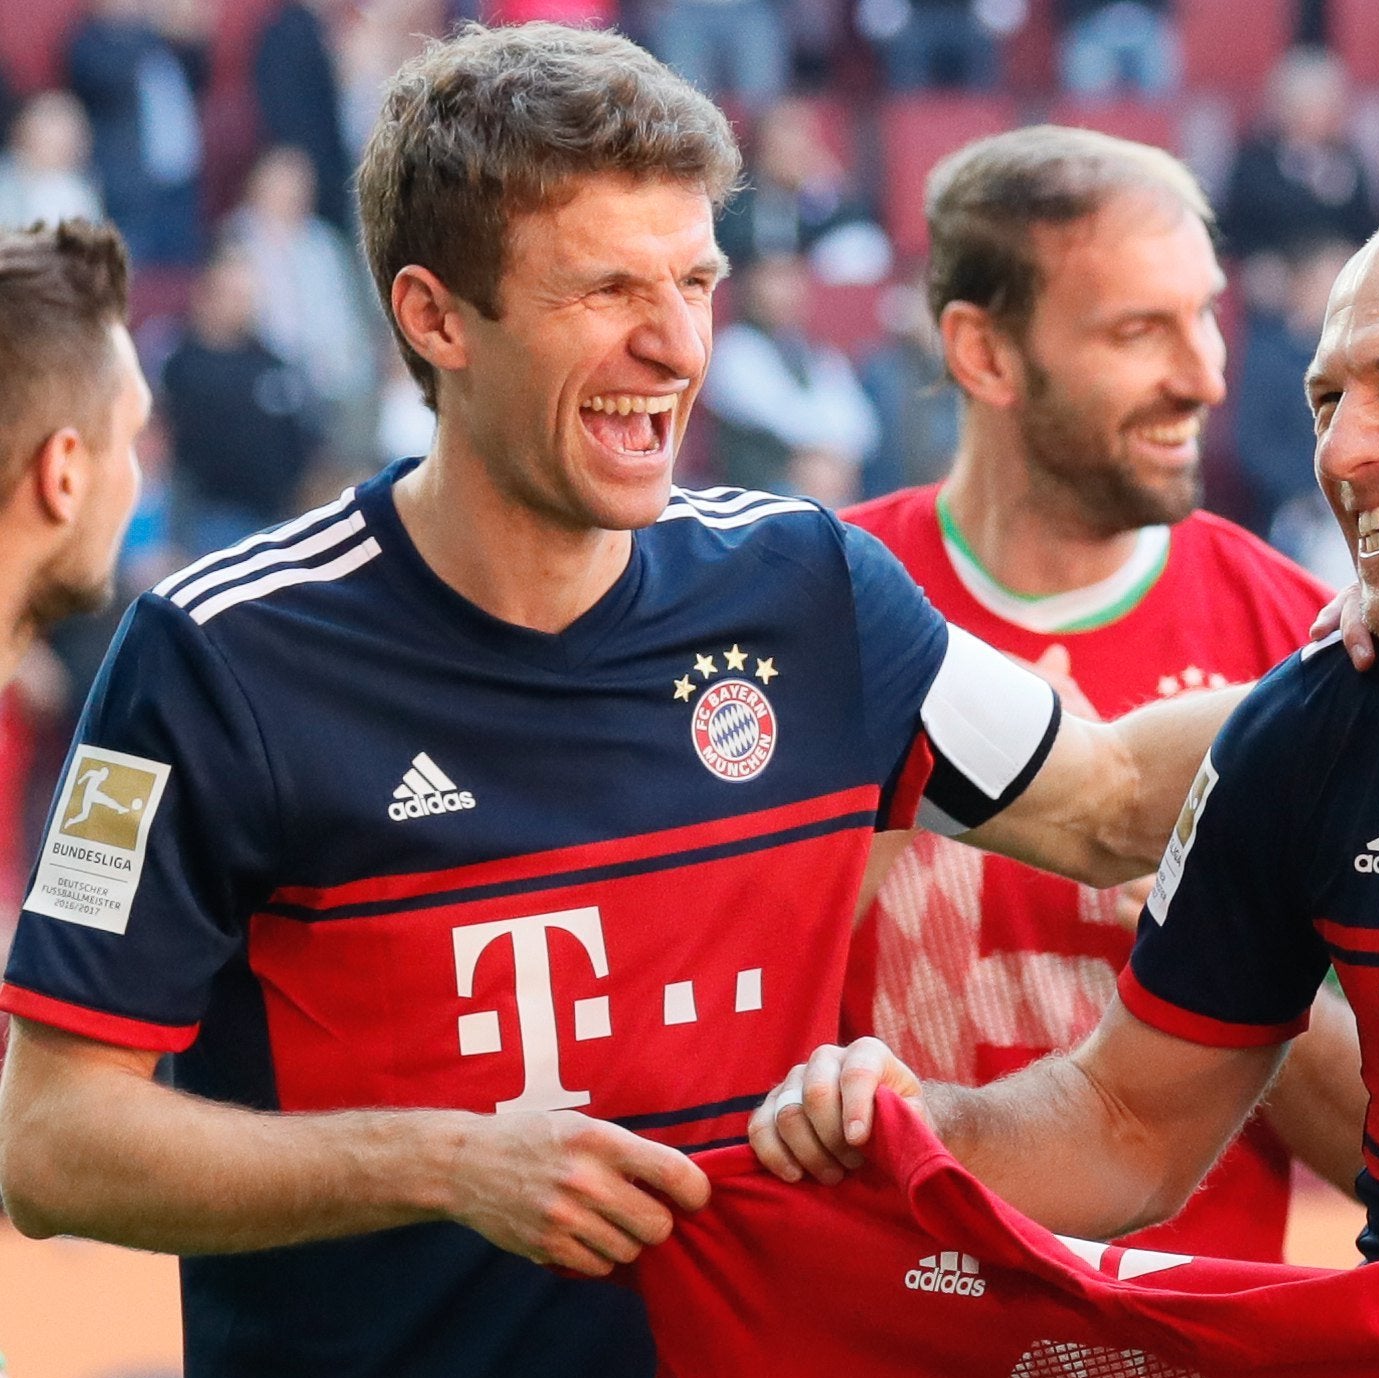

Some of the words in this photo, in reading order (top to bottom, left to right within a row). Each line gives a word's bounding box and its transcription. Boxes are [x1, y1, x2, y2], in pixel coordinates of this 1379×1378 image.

[696, 707, 710, 731] FC
[709, 685, 768, 719] BAYERN
[388, 788, 476, 822] adidas
[52, 842, 132, 872] BUNDESLIGA
[42, 885, 121, 911] FUSSBALLMEISTER
[58, 877, 109, 897] DEUTSCHER
[452, 906, 610, 1114] T
[905, 1267, 986, 1297] adidas
